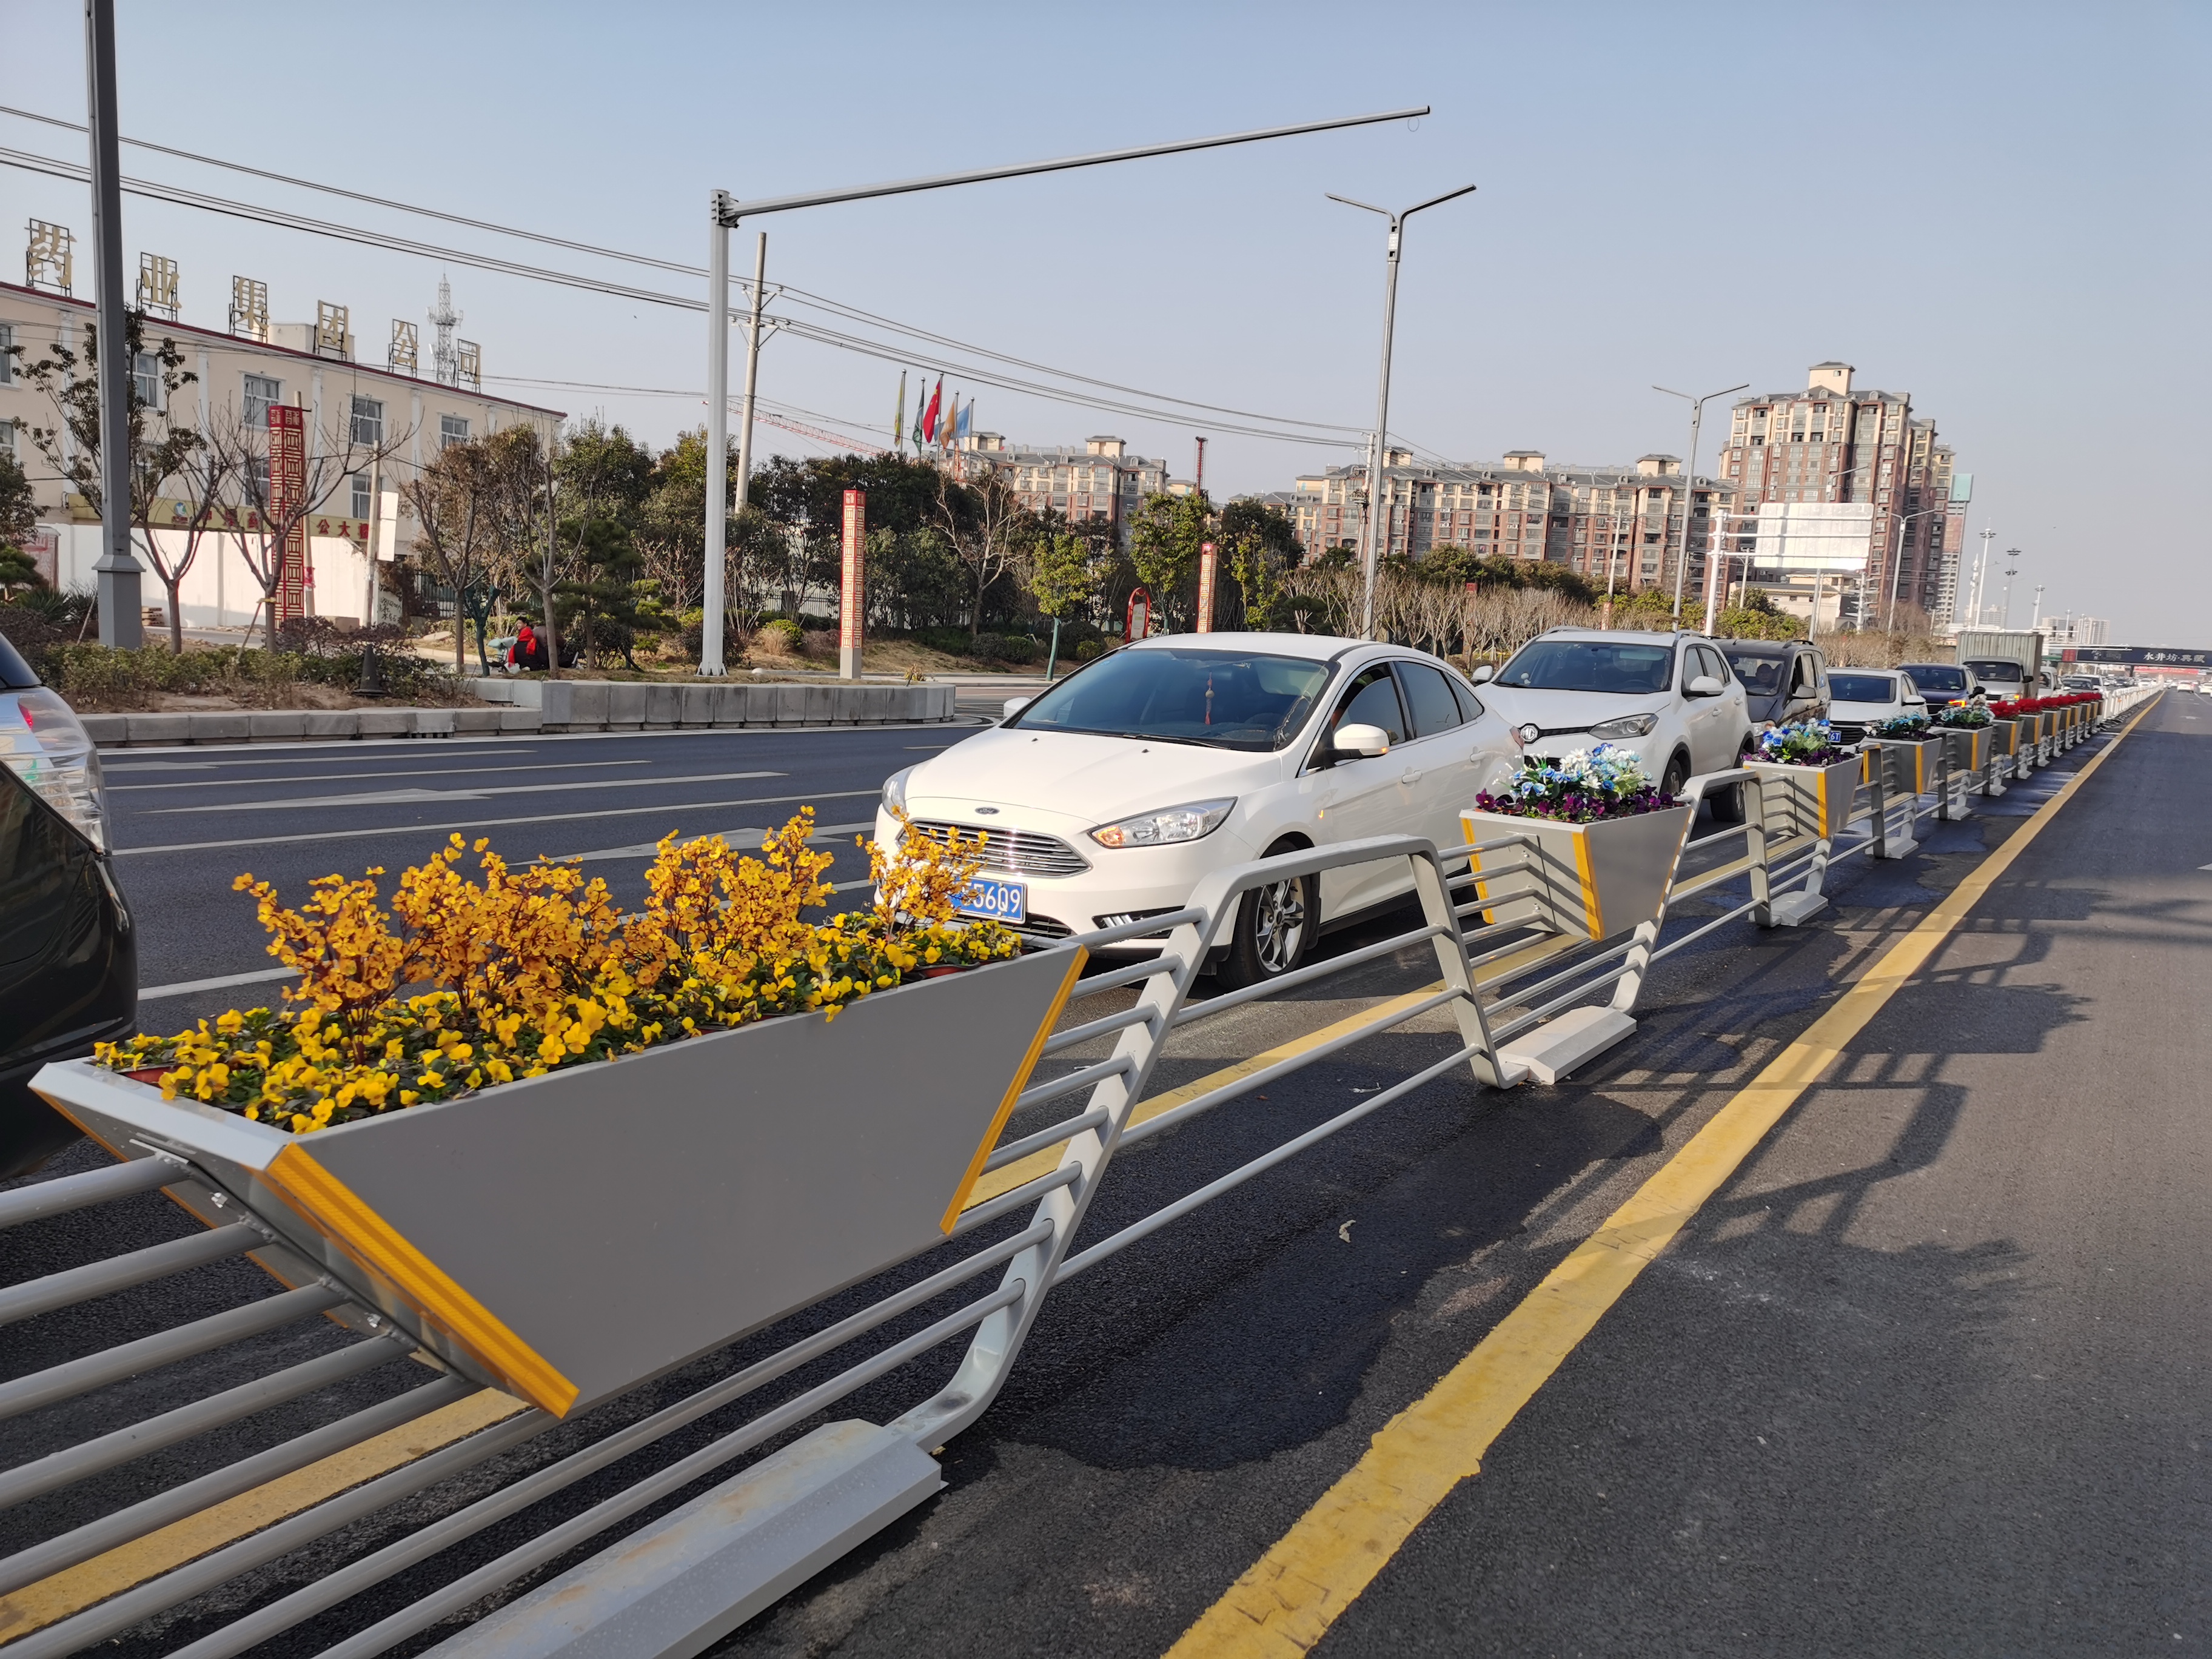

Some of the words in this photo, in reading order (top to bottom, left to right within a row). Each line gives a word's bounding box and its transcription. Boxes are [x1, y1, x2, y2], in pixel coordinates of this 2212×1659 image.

[24, 222, 481, 384] 药业集团公司
[1522, 727, 1535, 740] MG
